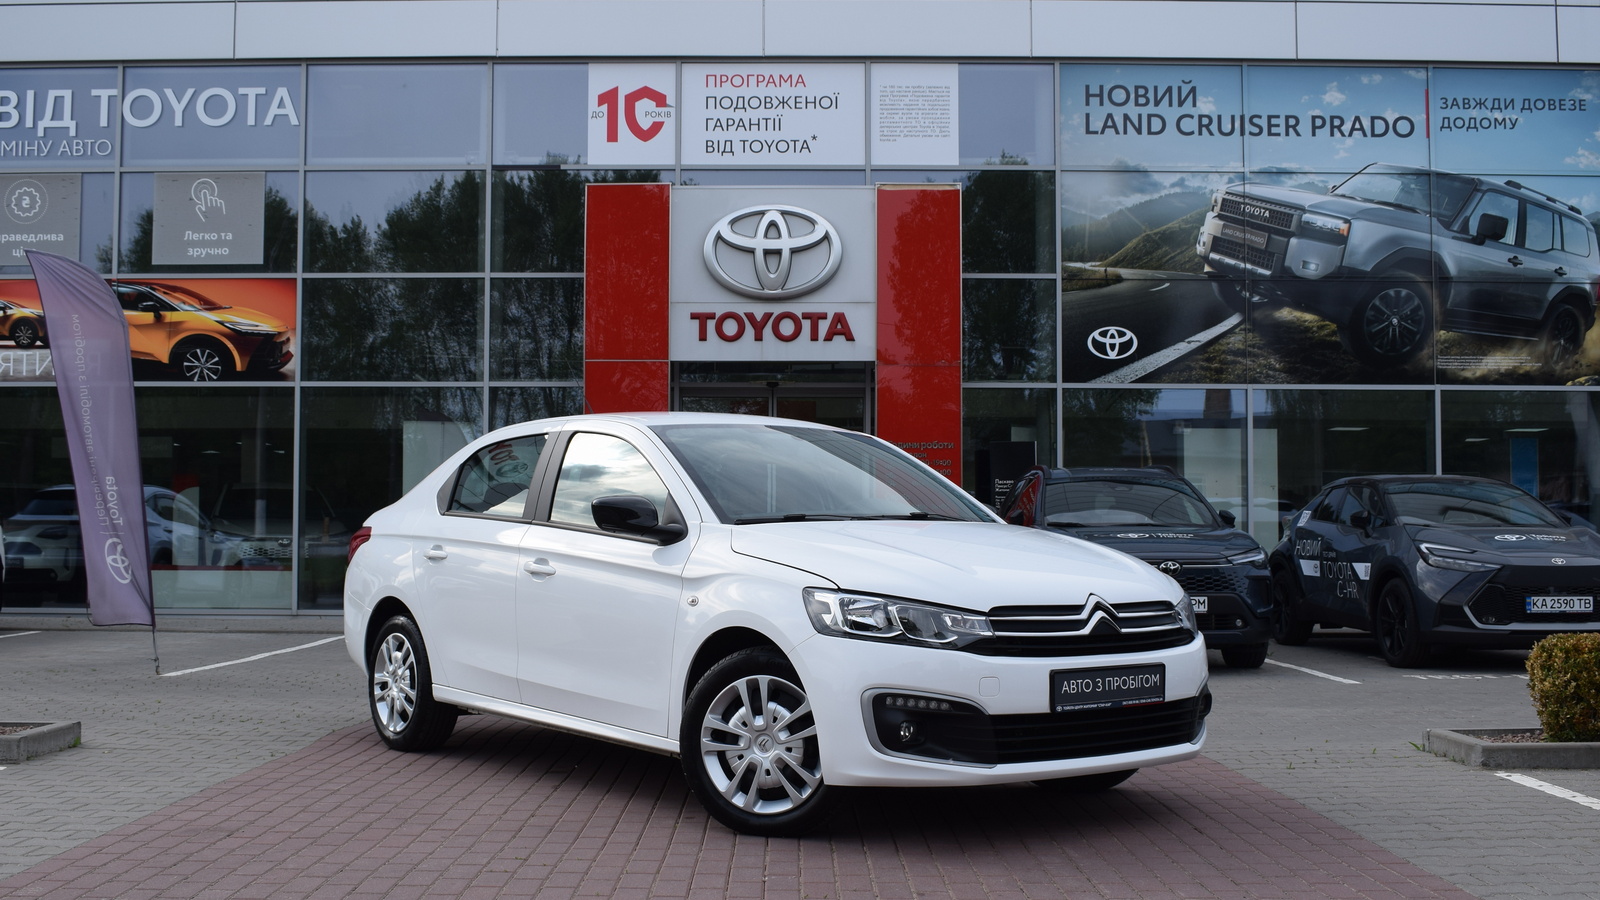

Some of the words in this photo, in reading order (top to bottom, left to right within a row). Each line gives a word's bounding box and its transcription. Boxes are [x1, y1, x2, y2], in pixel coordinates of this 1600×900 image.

[704, 74, 806, 88] ПРОГРАМА
[704, 92, 839, 112] ПОДОВЖЕНОЇ
[1084, 80, 1198, 108] НОВИЙ
[0, 89, 77, 137] ВІД
[91, 87, 300, 128] TOYOTA
[1439, 97, 1516, 113] ЗАВЖДИ
[1520, 98, 1587, 114] ДОВЕЗЕ
[591, 111, 604, 121] ДО
[644, 110, 672, 119] РОКІВ
[704, 114, 783, 132] ГАРАНТІЇ
[1439, 115, 1519, 132] ДОДОМУ
[1084, 112, 1167, 137] LAND
[1175, 113, 1302, 138] CRUISER
[1311, 114, 1416, 139] PRADO
[58, 139, 112, 156] АВТО
[704, 139, 735, 156] ВІД
[1240, 204, 1270, 218] TOYOTA
[0, 233, 64, 244] раведлива
[184, 231, 218, 241] Легко
[187, 246, 229, 257] зручно
[689, 311, 856, 343] TOYOTA
[920, 440, 954, 451] роботи
[1294, 537, 1321, 556] НОВИЙ
[1323, 561, 1354, 579] TOYOTA
[1336, 581, 1359, 599] C-HR
[1532, 598, 1548, 609] KA
[1550, 598, 1575, 609] 2590
[1577, 598, 1592, 609] TB
[1061, 679, 1093, 694] АВТО
[1095, 678, 1103, 692] З
[1105, 674, 1160, 691] ПРОБІГОМ
